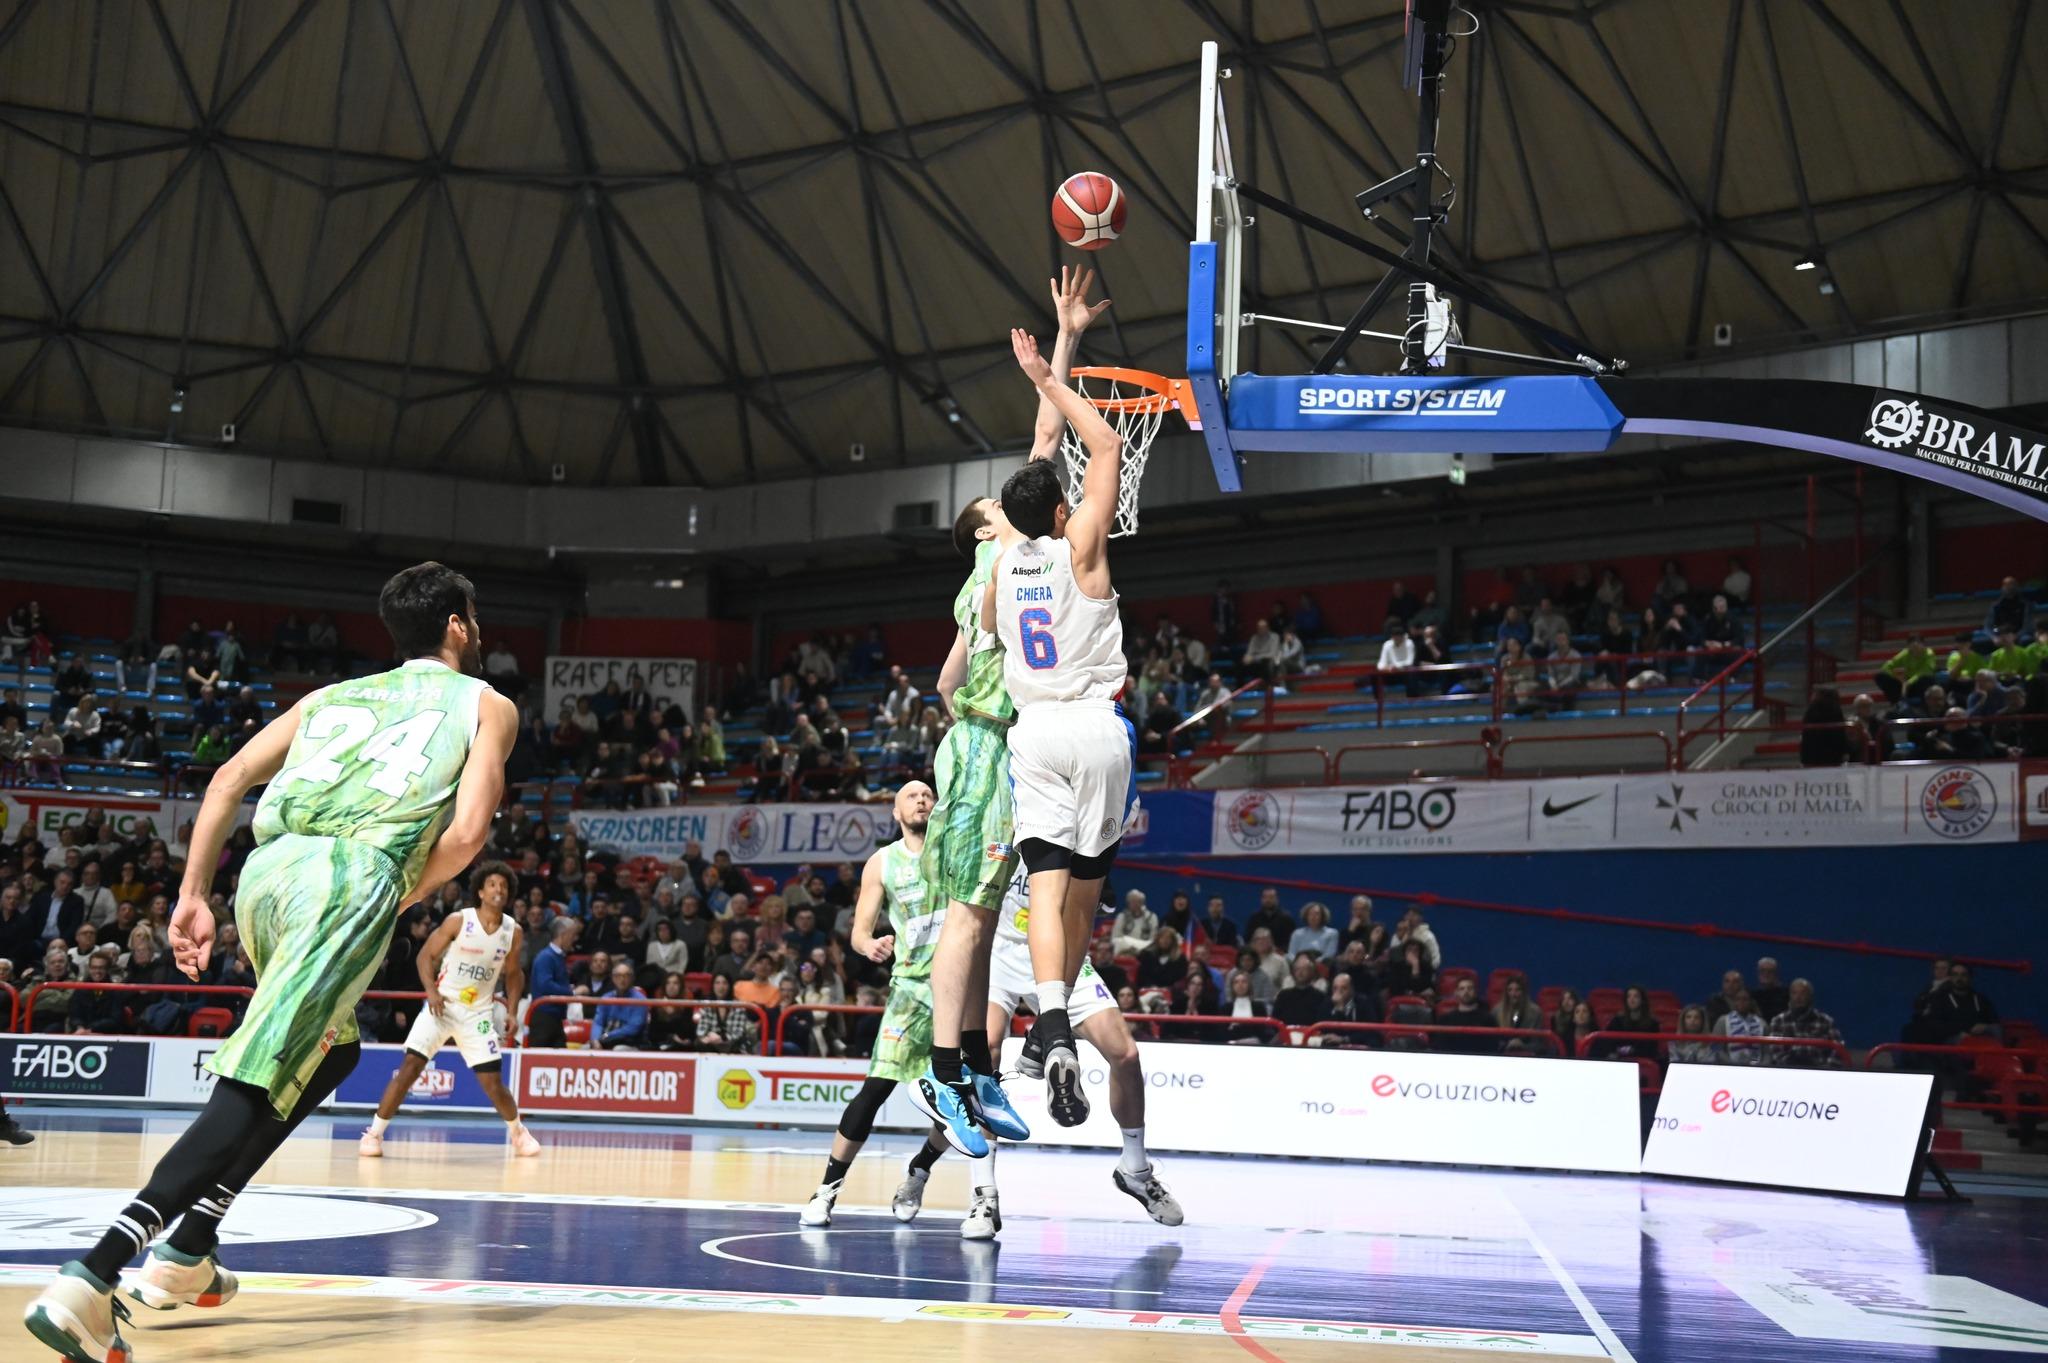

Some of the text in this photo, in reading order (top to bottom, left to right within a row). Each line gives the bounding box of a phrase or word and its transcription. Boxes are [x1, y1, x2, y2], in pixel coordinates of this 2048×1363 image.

[1300, 388, 1507, 415] SPORT SYSTEM
[1915, 447, 1956, 467] MACCHINE
[1955, 460, 1972, 472] PER
[2017, 475, 2044, 494] DELLA
[1016, 586, 1053, 601] CHIERA
[1019, 607, 1059, 670] 6
[649, 661, 696, 688] PER
[273, 703, 448, 800] 24
[1722, 781, 1852, 798] GRAND HOTEL
[1340, 787, 1457, 832] FABO
[1711, 798, 1863, 816] CROCE DI MALTA
[457, 962, 496, 982] FABO
[11, 1044, 109, 1079] FABO
[487, 1040, 498, 1054] 2
[559, 1067, 678, 1102] CASACOLOR
[758, 1070, 868, 1103] TECNIC
